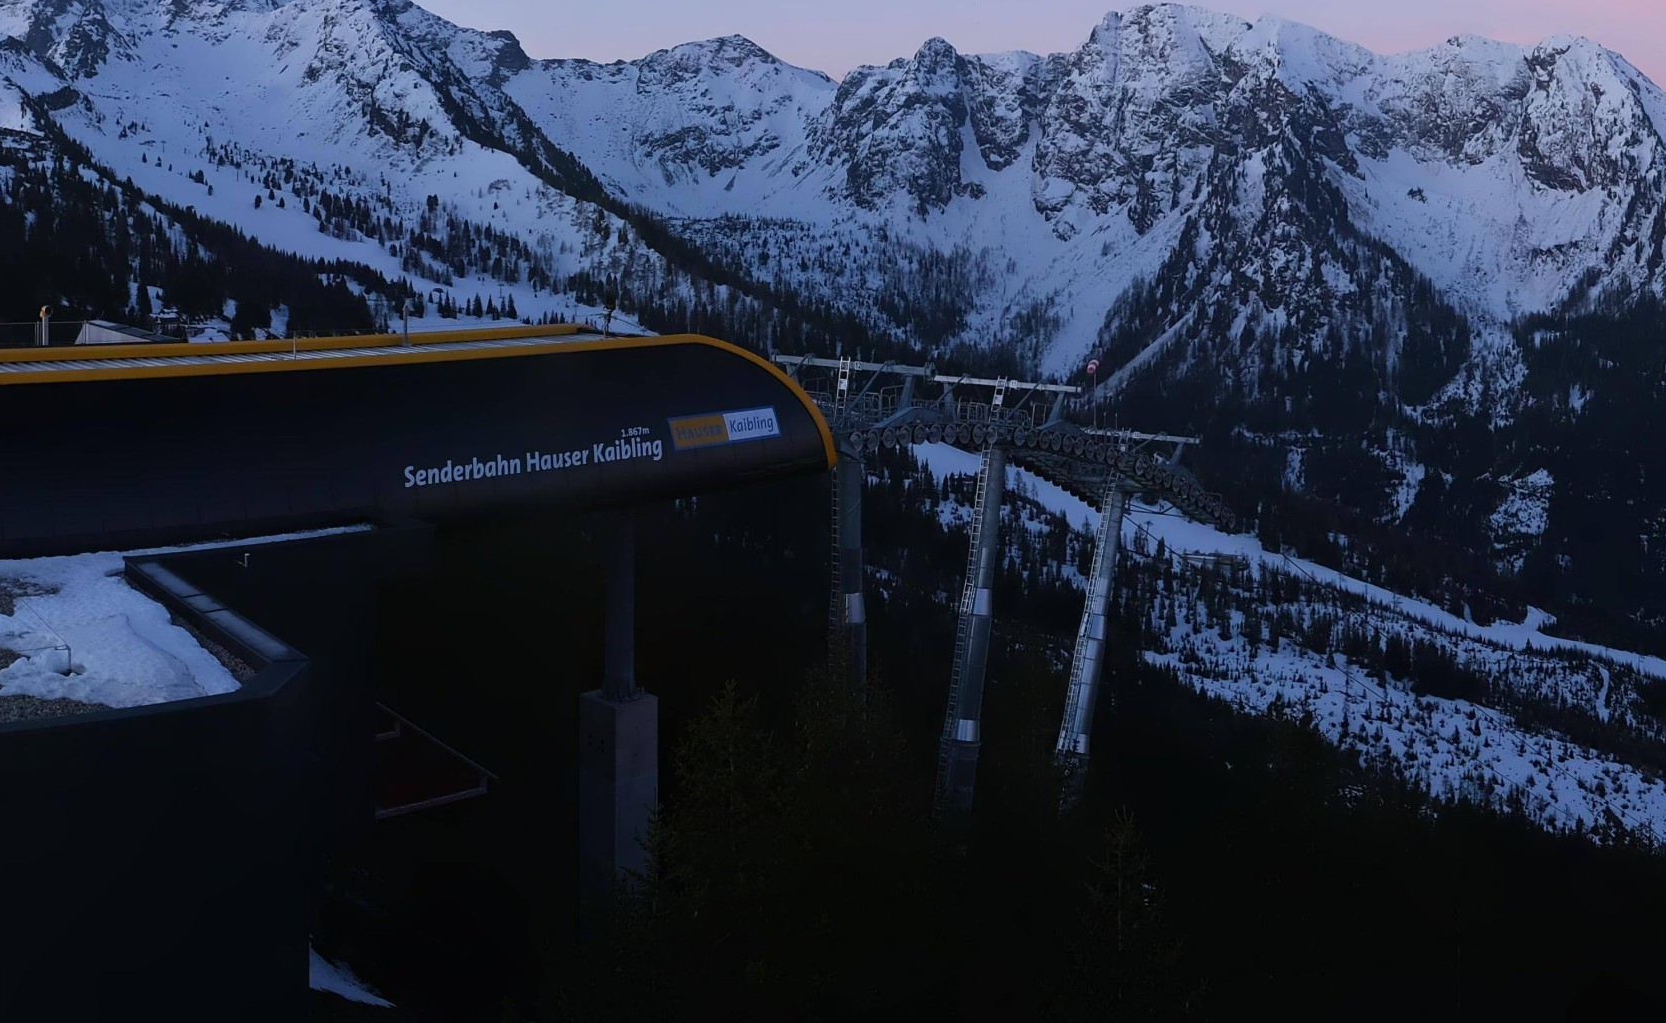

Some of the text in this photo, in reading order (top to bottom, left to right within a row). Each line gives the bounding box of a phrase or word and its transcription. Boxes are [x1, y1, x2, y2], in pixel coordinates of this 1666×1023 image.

[620, 426, 650, 437] 1.867m
[676, 414, 775, 440] HAUSER Kaibling
[404, 436, 663, 488] Senderbahn Hauser Kaibling
